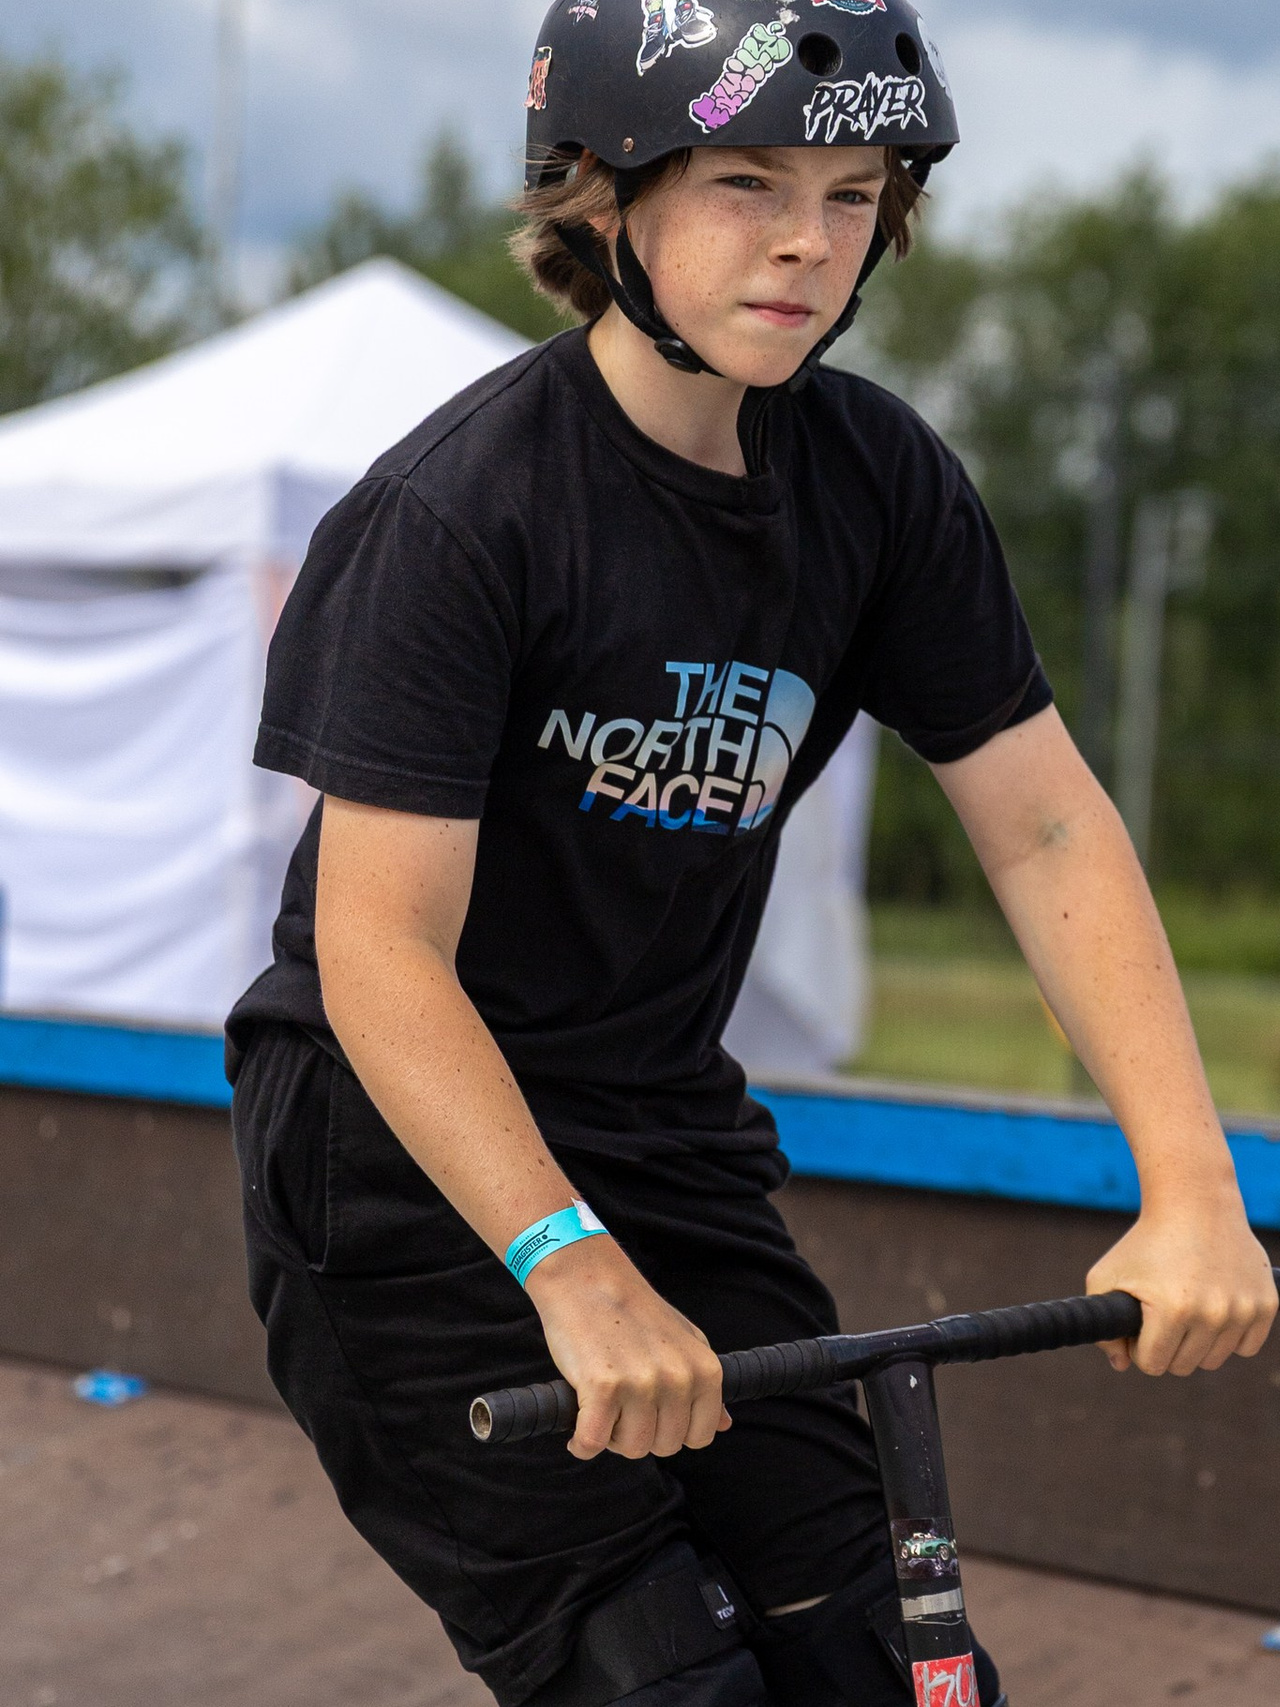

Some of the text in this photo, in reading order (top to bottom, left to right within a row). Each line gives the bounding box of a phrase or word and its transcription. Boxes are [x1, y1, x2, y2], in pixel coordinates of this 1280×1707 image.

[804, 72, 928, 142] PRAYER
[665, 660, 770, 725] THE
[537, 709, 756, 781] NORTH
[578, 763, 743, 833] FACE
[514, 1237, 543, 1267] MAGISTER
